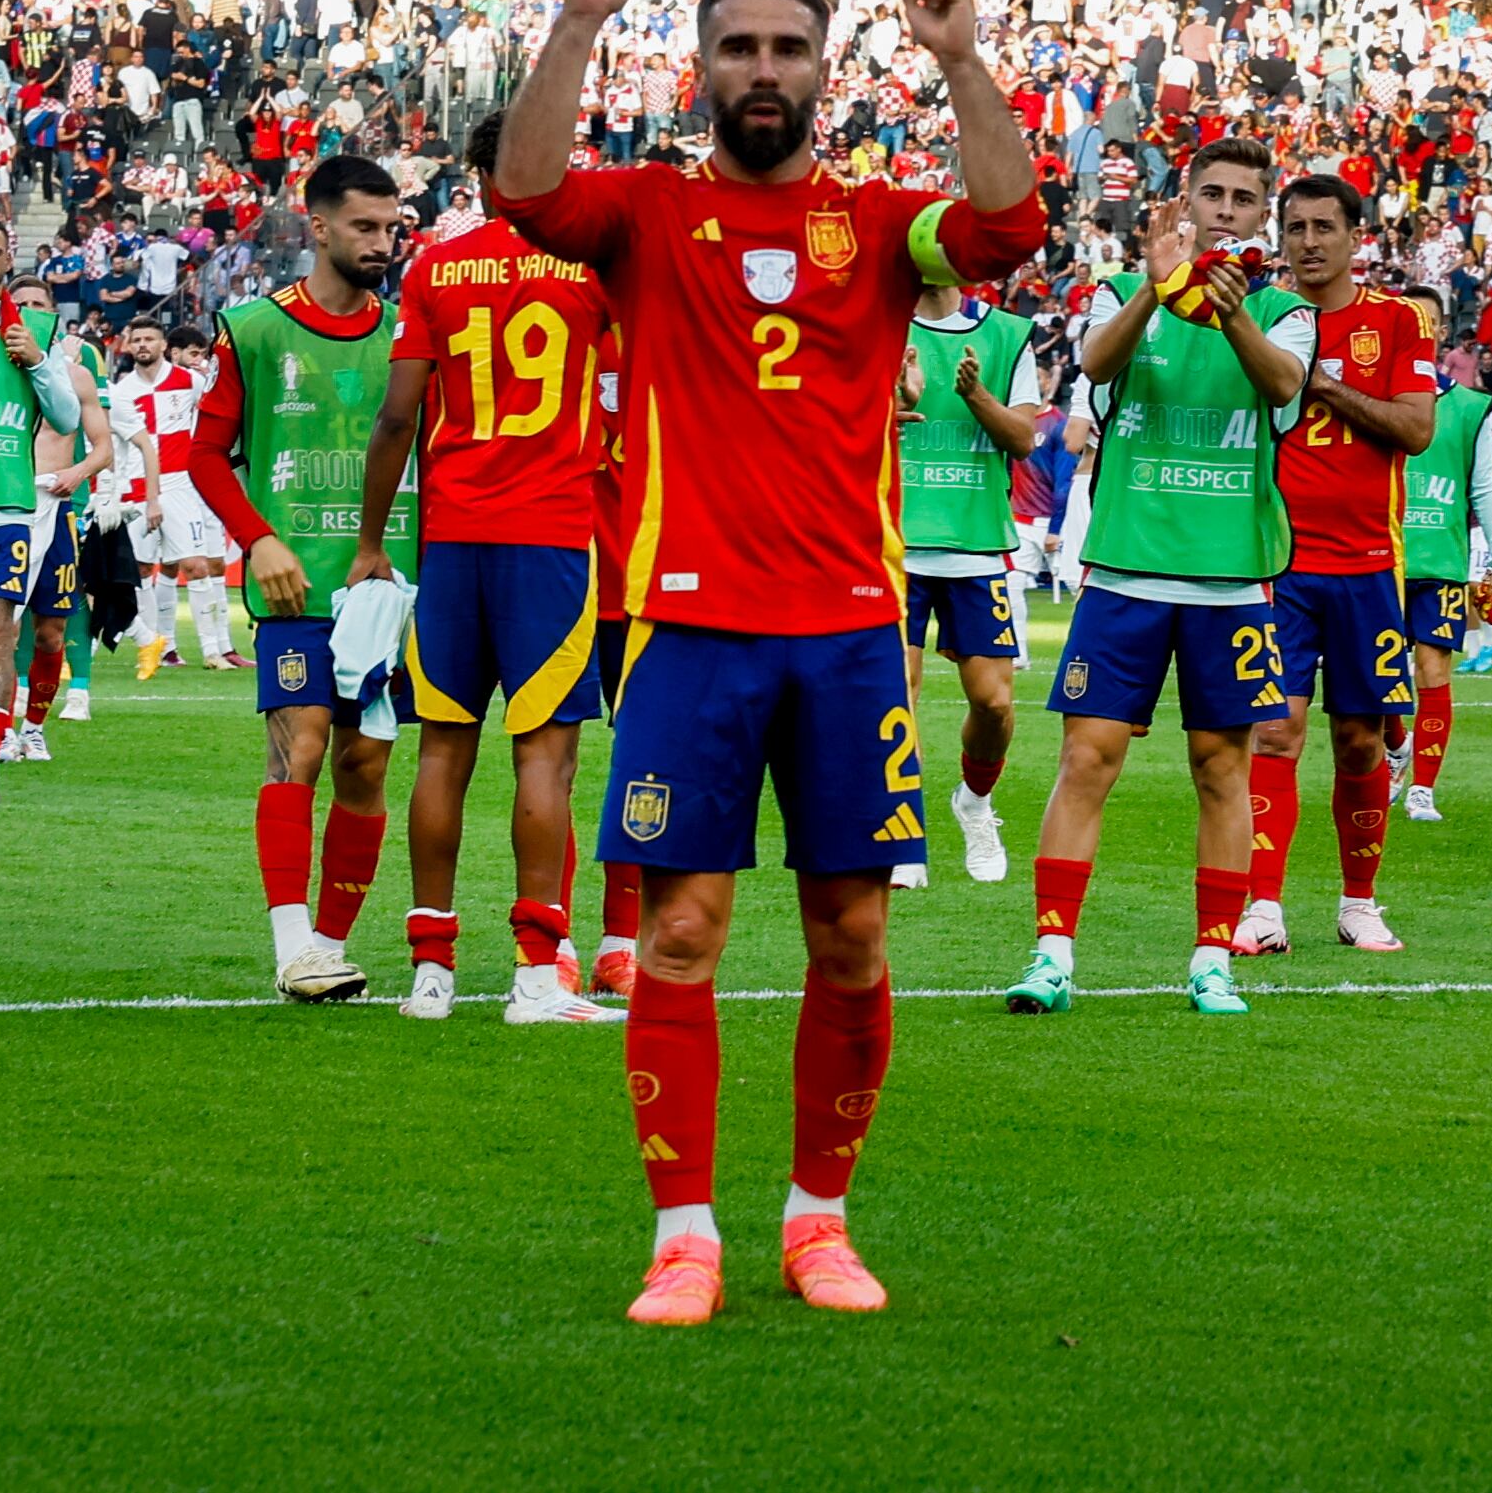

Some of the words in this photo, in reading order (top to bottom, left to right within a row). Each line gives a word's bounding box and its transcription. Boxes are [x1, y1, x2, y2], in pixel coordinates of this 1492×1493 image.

[430, 257, 510, 286] LAMINE
[752, 312, 802, 390] 2
[448, 301, 569, 441] 19
[1160, 465, 1253, 489] RESPECT
[189, 521, 204, 541] 17
[9, 540, 28, 574] 9
[54, 563, 76, 594] 10
[990, 580, 1011, 621] 5
[1437, 583, 1462, 621] 12
[1231, 623, 1283, 681] 25
[879, 706, 922, 793] 2
